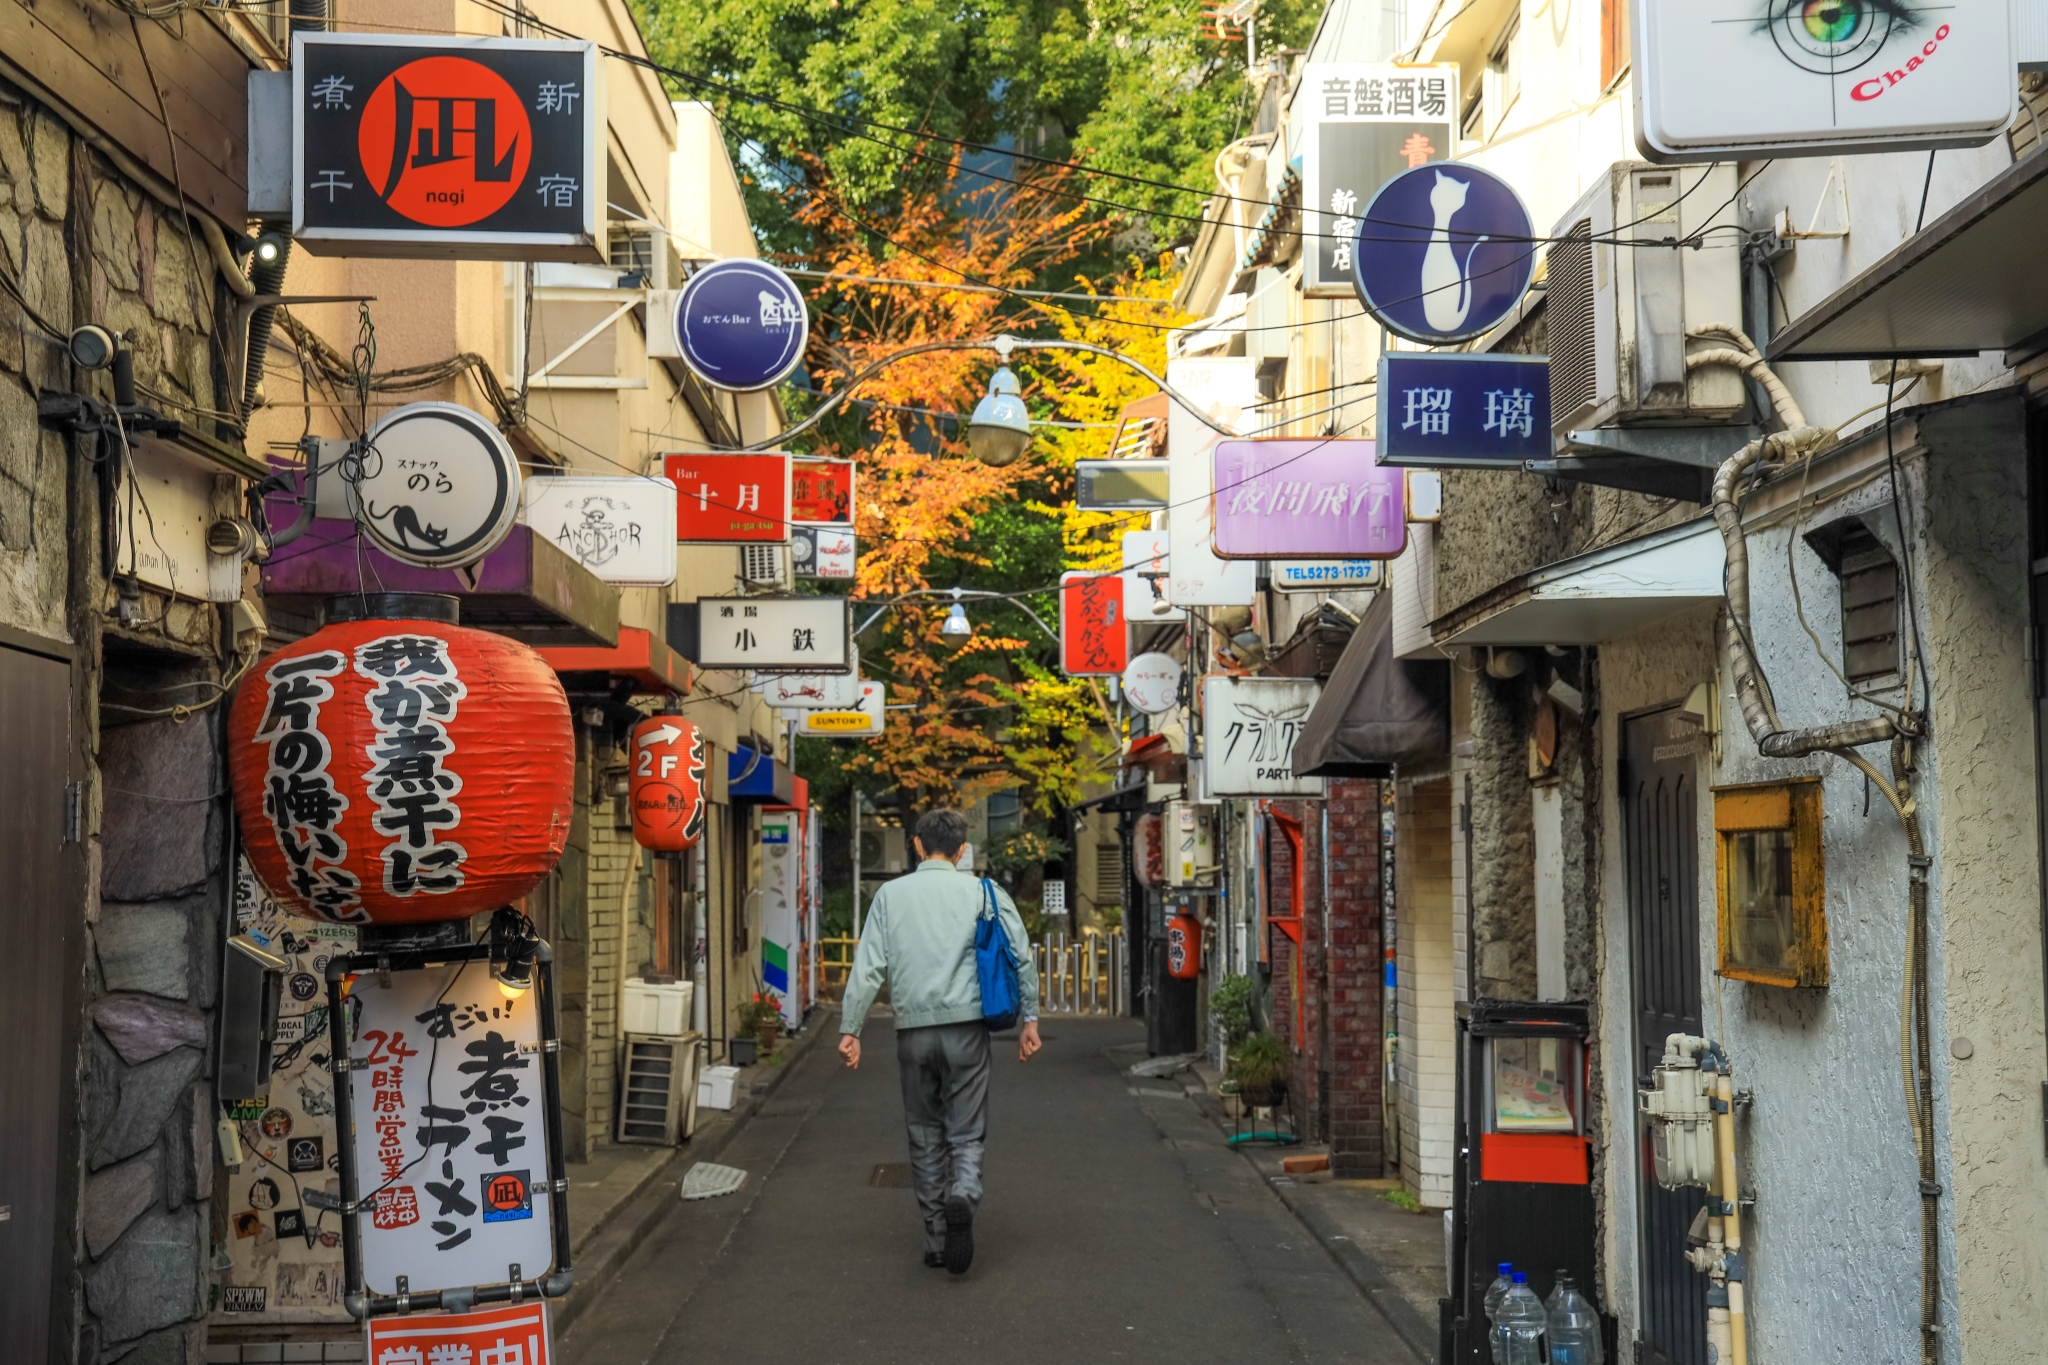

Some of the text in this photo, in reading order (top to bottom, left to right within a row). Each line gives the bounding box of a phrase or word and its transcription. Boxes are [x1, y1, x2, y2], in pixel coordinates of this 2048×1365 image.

[1850, 23, 1950, 101] Chaco
[1322, 77, 1446, 116] 音盤酒場
[310, 74, 354, 203] 煮干
[535, 80, 581, 208] 新宿
[426, 189, 465, 206] nagi
[1331, 188, 1357, 272] 新宿店
[1402, 387, 1534, 438] 瑠璃
[397, 459, 438, 470] スナック
[676, 468, 699, 479] Bar
[408, 472, 453, 494] のら
[691, 484, 760, 511] 十月
[555, 521, 642, 552] ANCHOR
[819, 566, 849, 577] Queen
[720, 605, 757, 617] 酒場
[735, 628, 815, 651] 小鉄
[816, 717, 864, 725] SUNTORY
[637, 750, 679, 779] 2F
[1257, 768, 1291, 780] PART
[457, 1031, 531, 1166] 煮干
[415, 1105, 477, 1251] ラーメン
[499, 1212, 516, 1220] nagi
